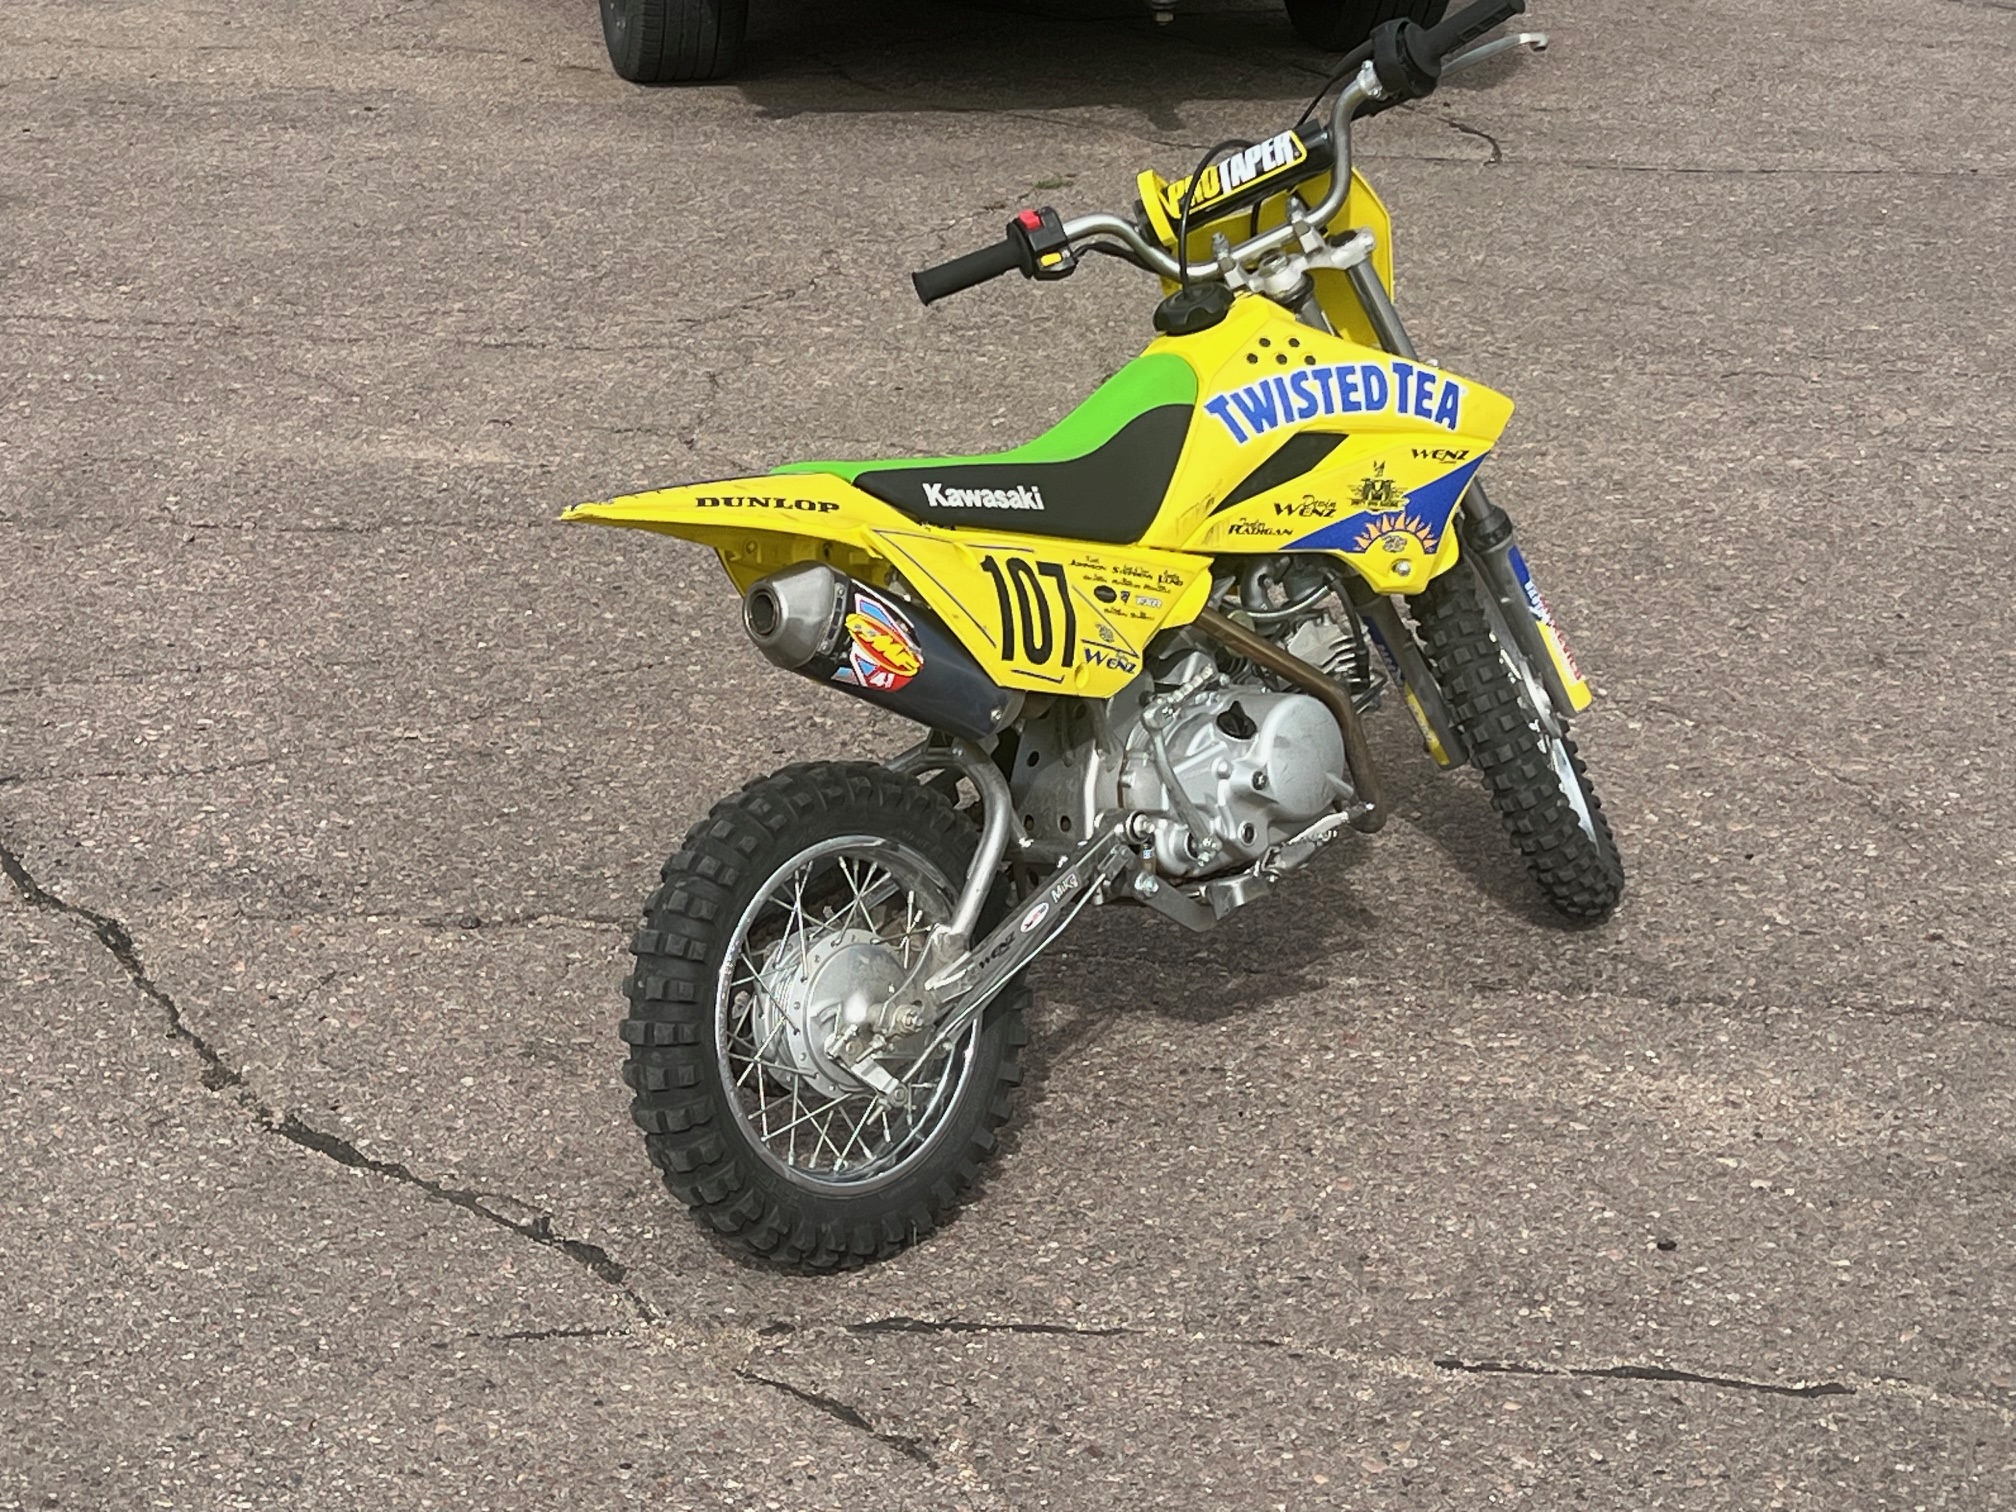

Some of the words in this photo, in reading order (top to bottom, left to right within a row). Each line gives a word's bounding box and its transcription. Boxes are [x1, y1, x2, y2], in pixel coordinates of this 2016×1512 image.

[1204, 364, 1388, 444] TWISTED
[1392, 362, 1462, 430] TEA
[1411, 448, 1470, 461] WENZ
[696, 496, 840, 513] DUNLOP
[922, 482, 1045, 511] Kawasaki
[980, 554, 1077, 668] 107
